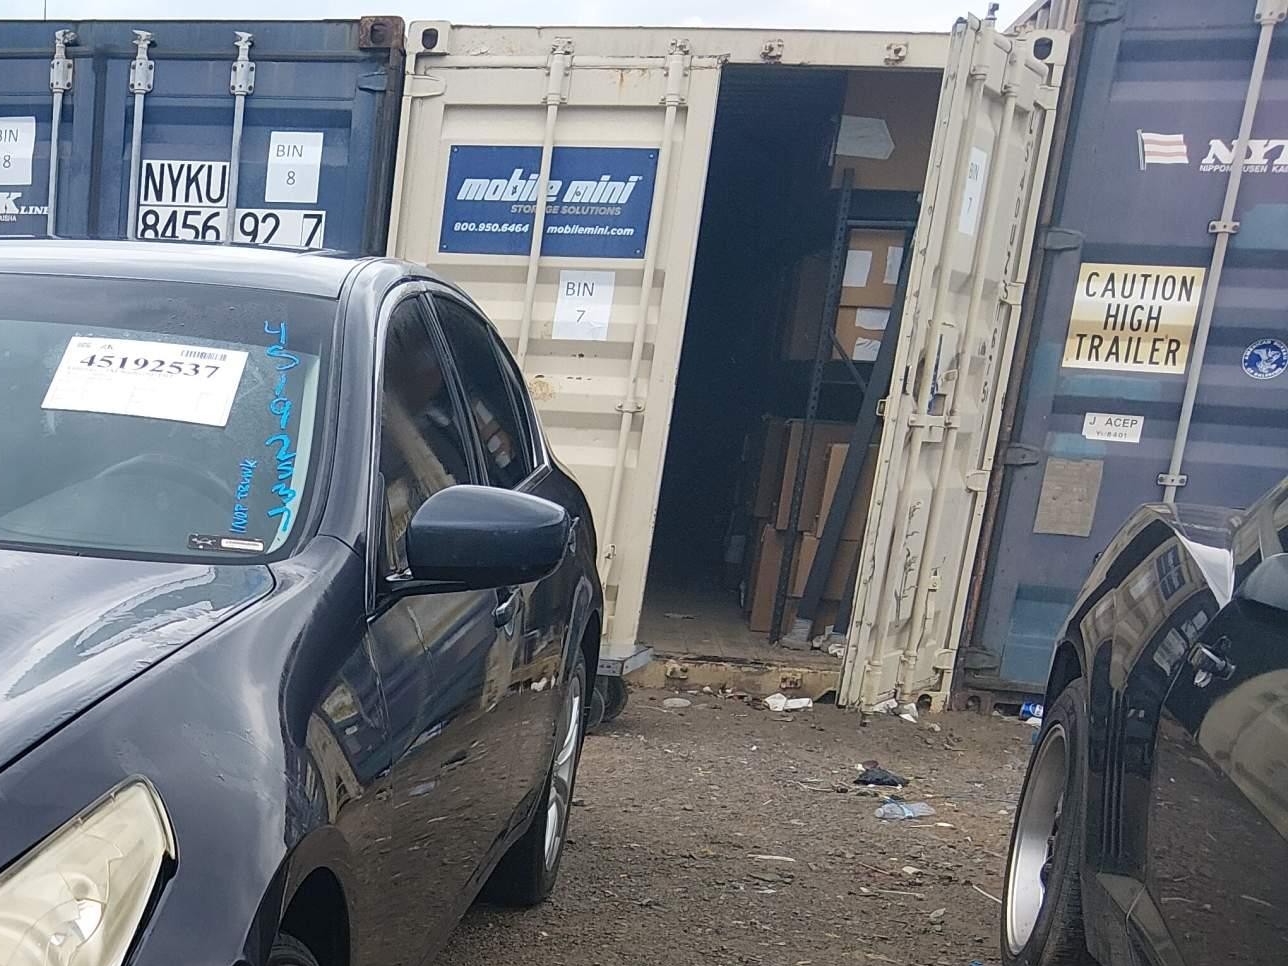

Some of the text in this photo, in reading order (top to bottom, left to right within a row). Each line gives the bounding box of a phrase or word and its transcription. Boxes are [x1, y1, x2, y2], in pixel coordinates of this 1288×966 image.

[276, 144, 304, 158] BIN
[2, 154, 12, 169] 8
[143, 162, 228, 204] NYKU
[286, 170, 296, 186] 8
[563, 175, 641, 204] mini
[560, 205, 622, 216] SOLUTIONS
[453, 222, 635, 236] 800.950.6464 mobilemini.com
[565, 281, 596, 297] BIN
[1085, 271, 1196, 302] CAUTION
[576, 309, 587, 323] 7
[1103, 302, 1163, 333] HIGH
[1075, 333, 1182, 367] TRAILER
[79, 353, 222, 379] 45192537
[1089, 416, 1138, 429] J ACEP
